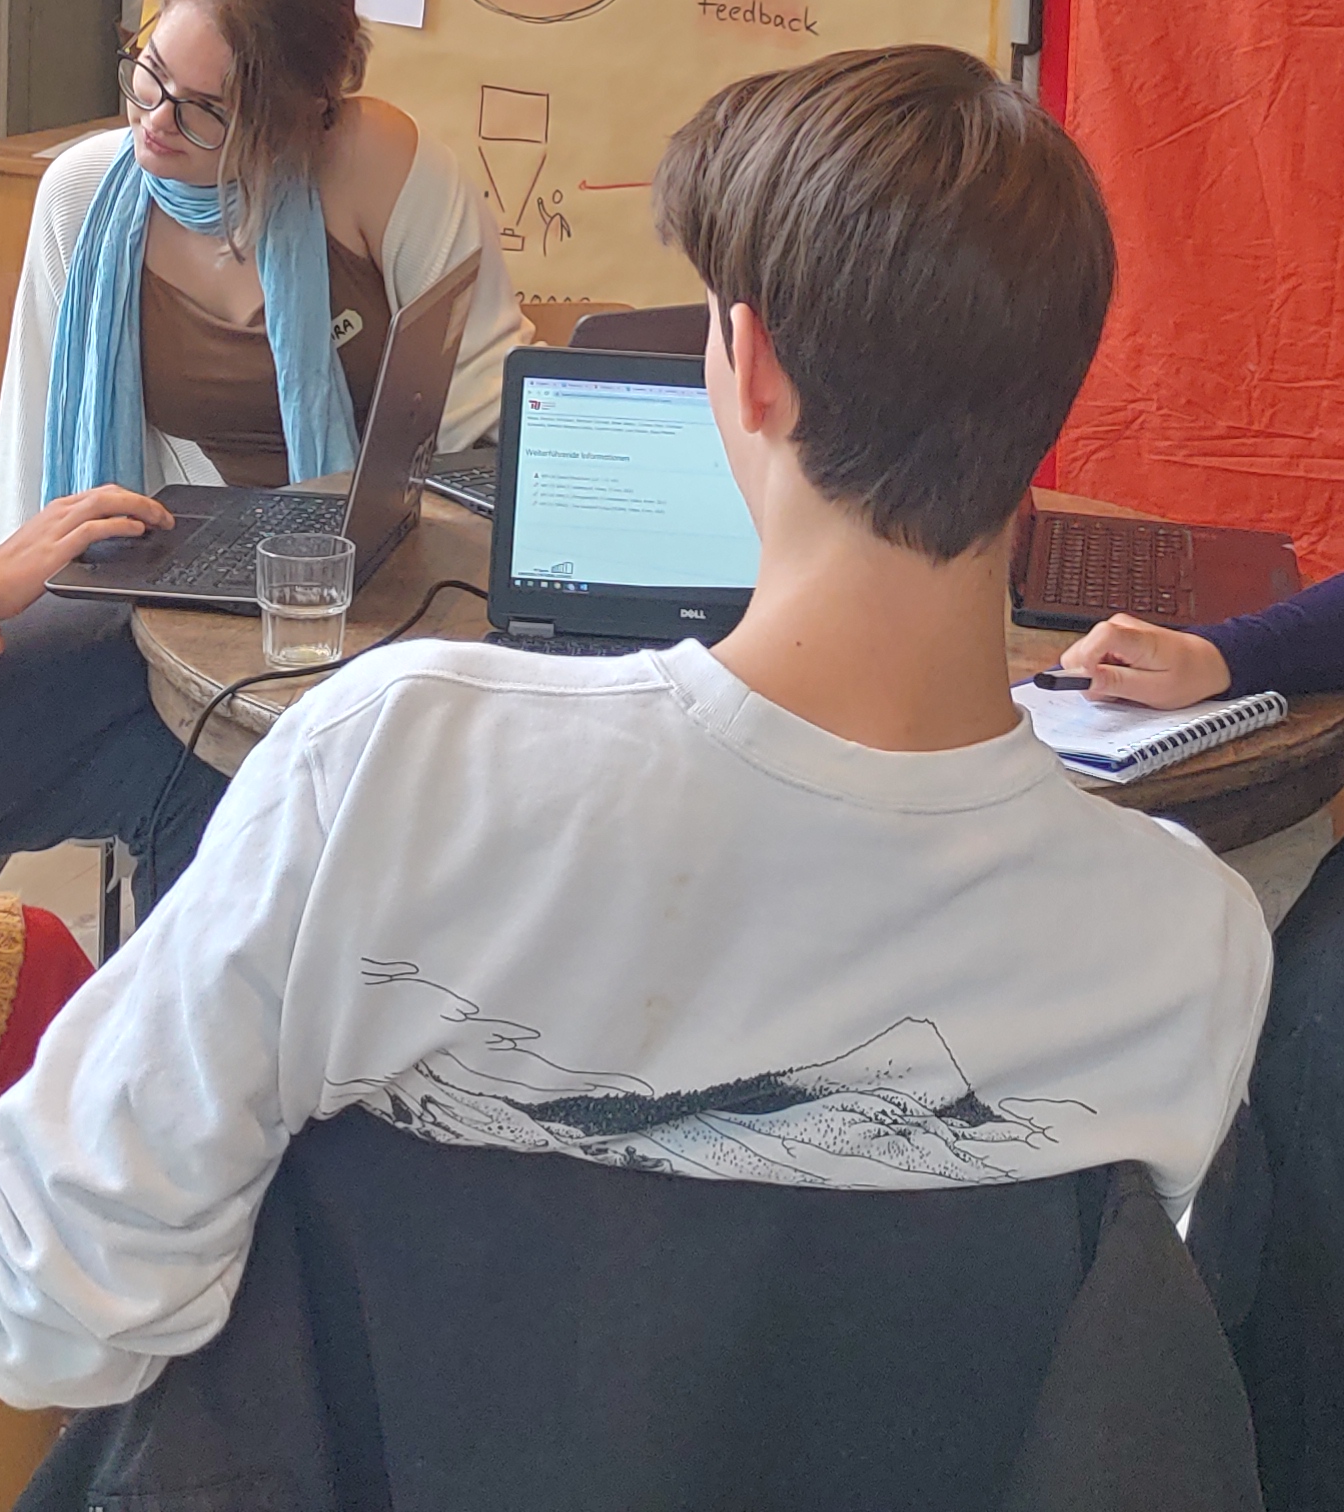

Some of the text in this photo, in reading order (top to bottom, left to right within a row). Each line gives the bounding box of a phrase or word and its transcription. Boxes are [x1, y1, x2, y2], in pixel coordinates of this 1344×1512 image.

[526, 448, 630, 463] Weiterführende Informationen
[680, 608, 706, 620] DELL
